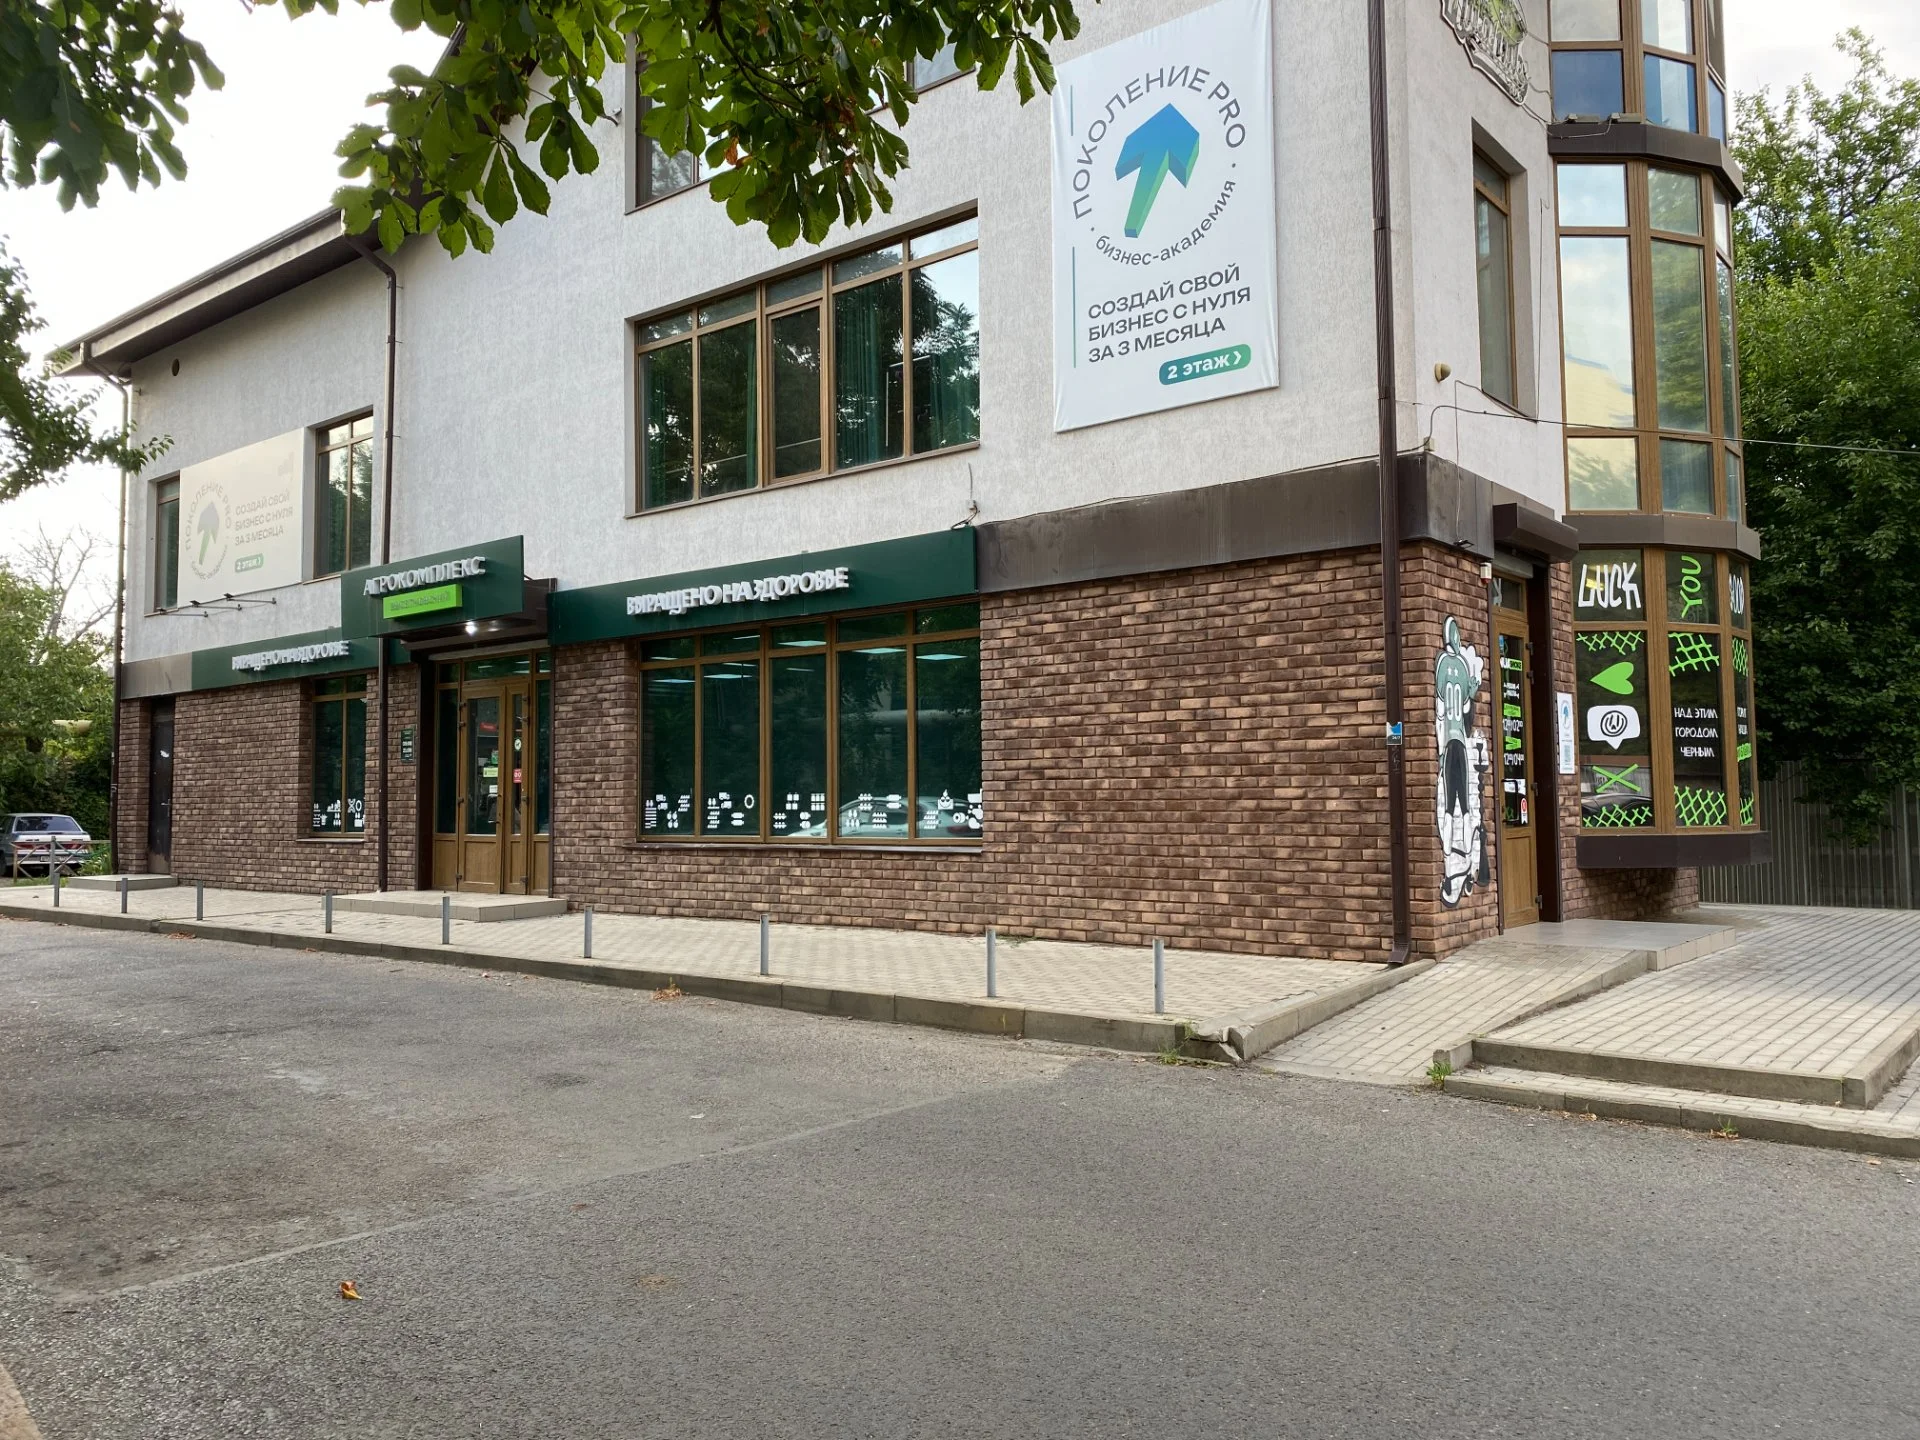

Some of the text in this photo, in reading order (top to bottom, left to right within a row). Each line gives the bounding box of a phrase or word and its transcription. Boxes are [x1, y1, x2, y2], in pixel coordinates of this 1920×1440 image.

[1073, 66, 1246, 219] ПОКОЛЕНИЕ PRO
[1096, 180, 1236, 265] бизнес-академия
[1088, 263, 1240, 319] СОЗДАЙ СВОЙ
[1088, 286, 1251, 341] БИЗНЕС С НУЛЯ
[1088, 345, 1115, 363] ЗА
[1134, 317, 1226, 352] МЕСЯЦА
[1167, 353, 1231, 380] 2 этаж
[235, 495, 268, 516] СОЗДАЙ
[235, 515, 265, 532] БИЗНЕС
[363, 556, 486, 596] АГРОКОМПЛЕКС
[626, 567, 849, 615] ВЫРАЩЕНО НА ЗДОРОВЬЕ
[1577, 561, 1641, 610] LUCK
[1679, 555, 1702, 618] YOU
[1674, 707, 1718, 719] НАД ЭТИМ
[1675, 726, 1718, 738] ГОРОДОМ
